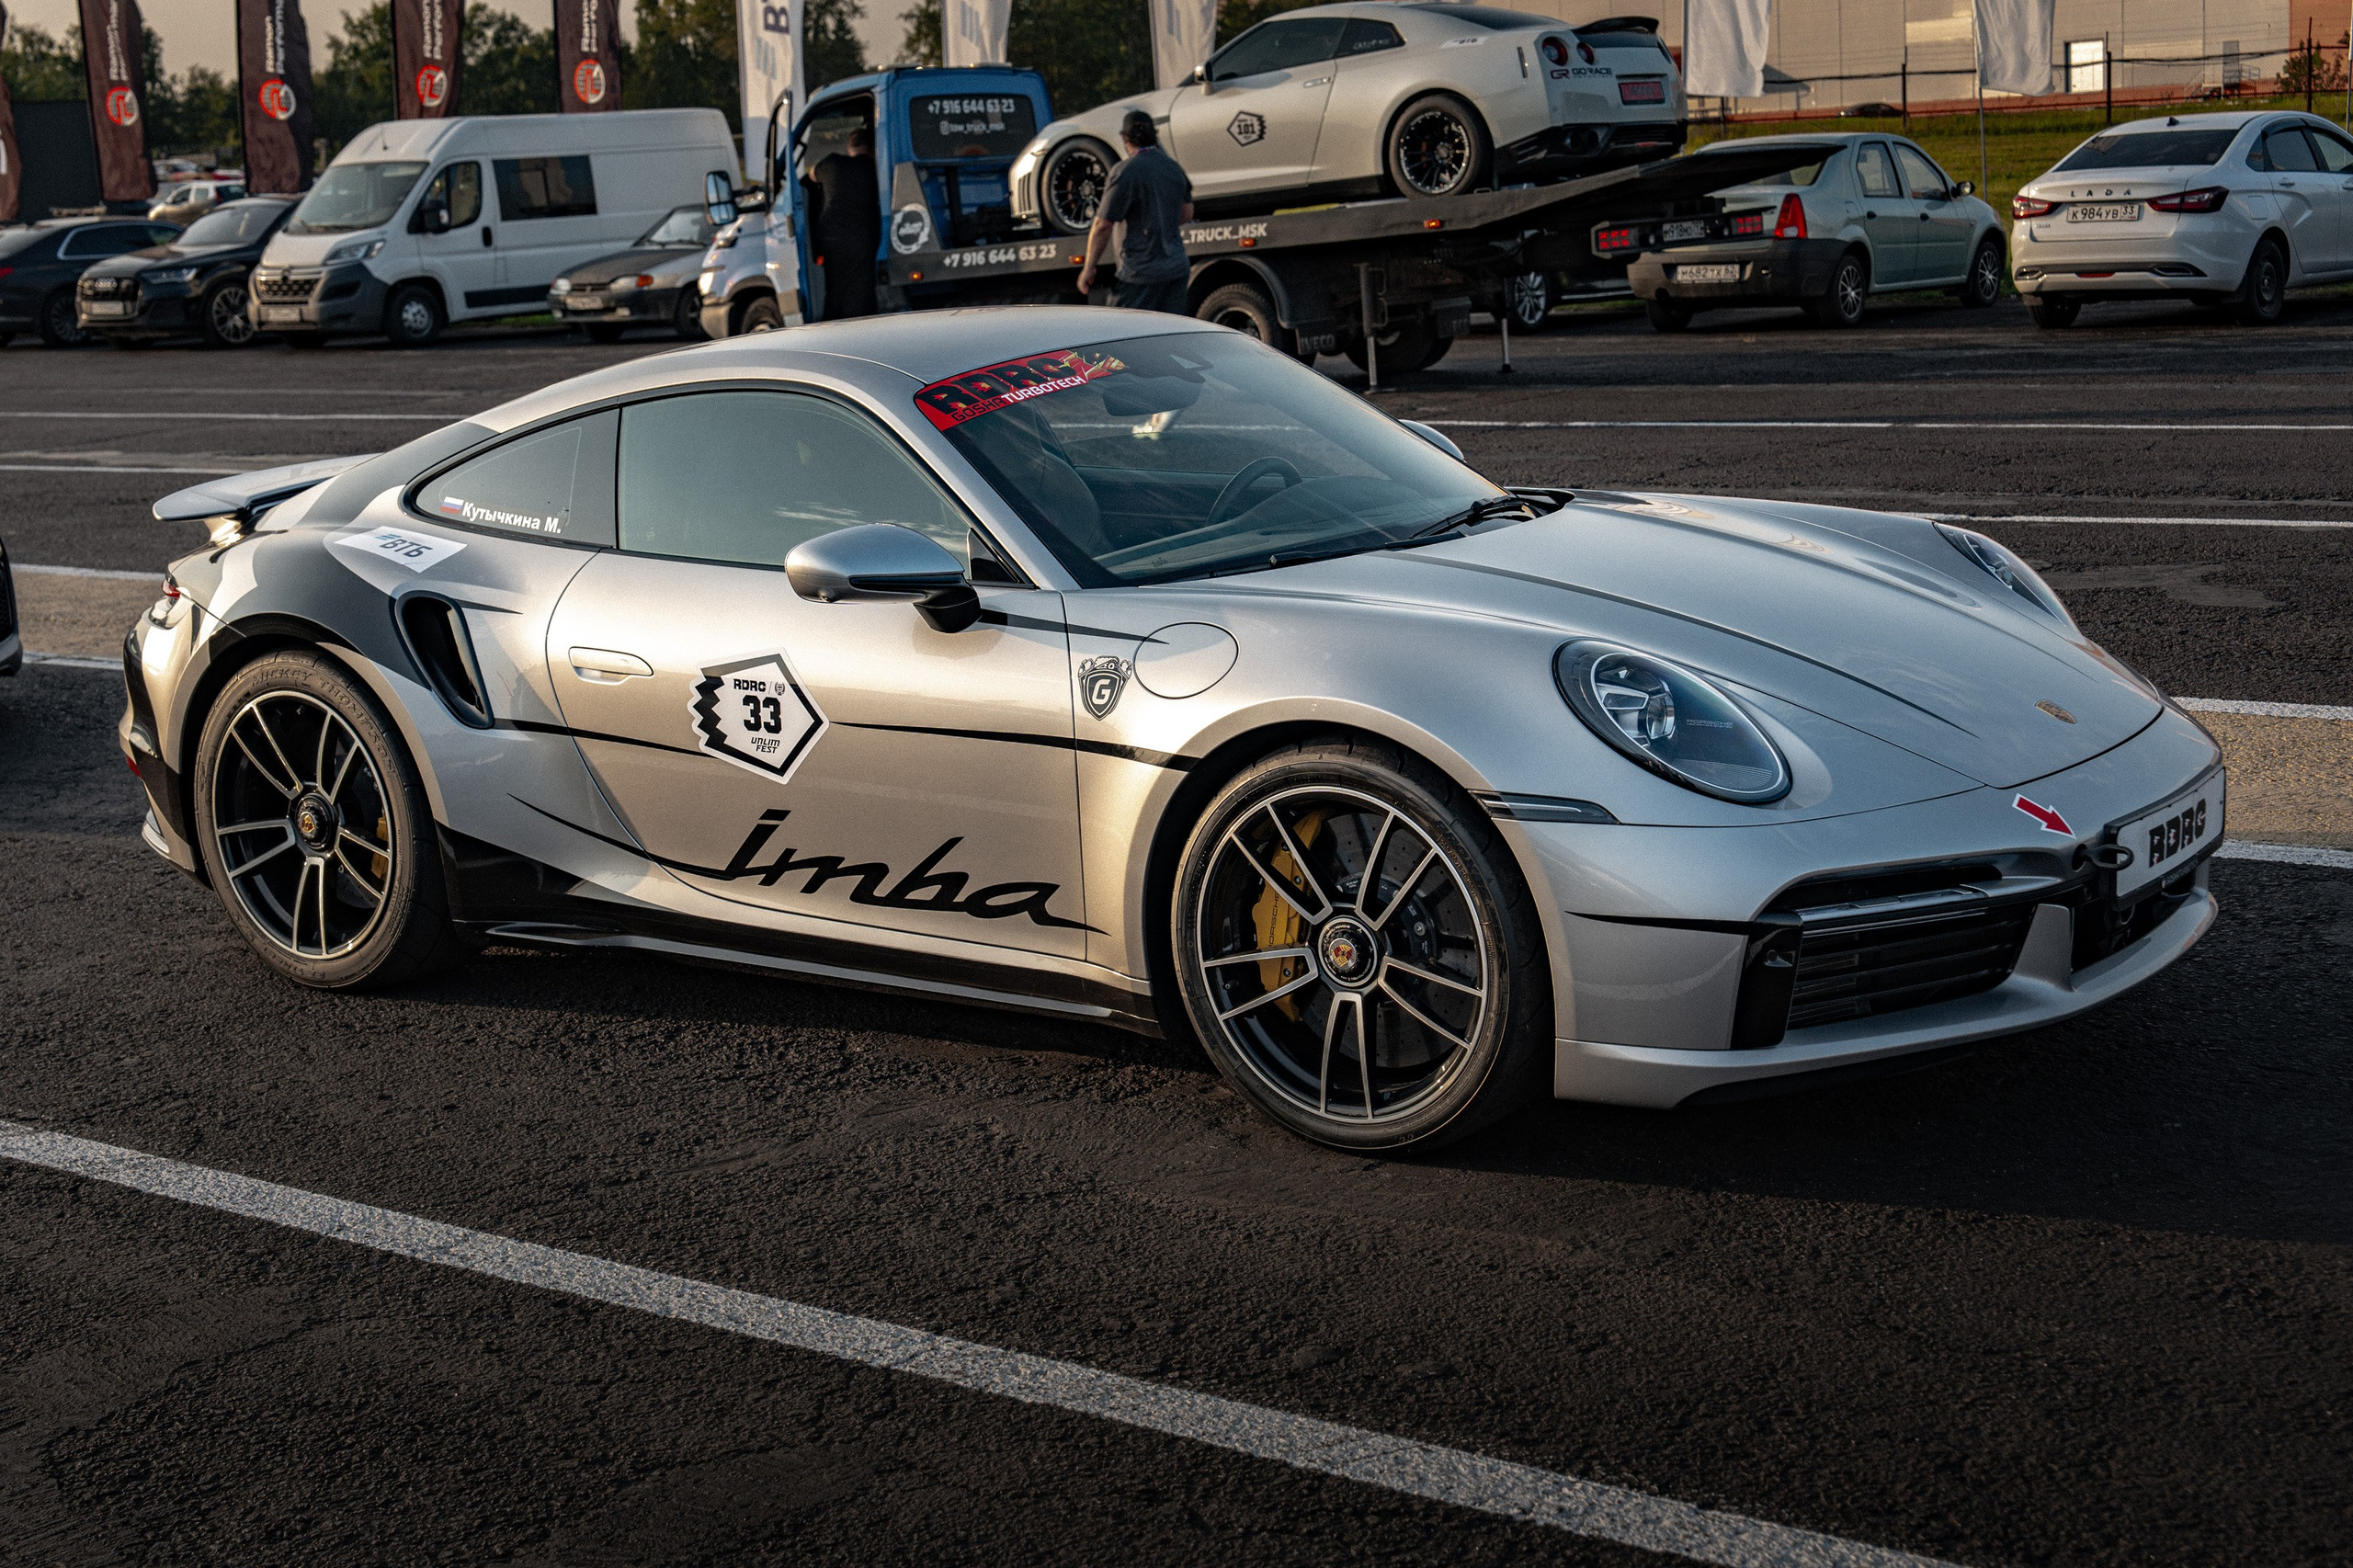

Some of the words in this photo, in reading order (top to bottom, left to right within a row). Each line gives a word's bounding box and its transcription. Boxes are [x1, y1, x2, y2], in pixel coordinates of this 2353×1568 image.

[942, 99, 961, 114] 916
[962, 99, 984, 113] 644
[986, 98, 1000, 112] 63
[1002, 98, 1015, 112] 23
[1237, 123, 1256, 135] 101
[2070, 188, 2131, 197] LADA
[2122, 205, 2134, 215] 33
[943, 253, 961, 267] +7
[962, 250, 986, 267] 916
[988, 247, 1017, 265] 644
[1018, 244, 1037, 261] 63
[1039, 244, 1057, 258] 23
[461, 501, 541, 530] Кутычкина
[543, 516, 562, 533] М.
[379, 539, 434, 557] ВТБ
[252, 667, 313, 687] MICKEY
[733, 678, 767, 693] RDRC
[742, 694, 782, 734] 33
[750, 736, 780, 747] UNLIM
[756, 745, 779, 754] FEST
[2148, 798, 2206, 868] RDRC
[723, 808, 1113, 937] imba
